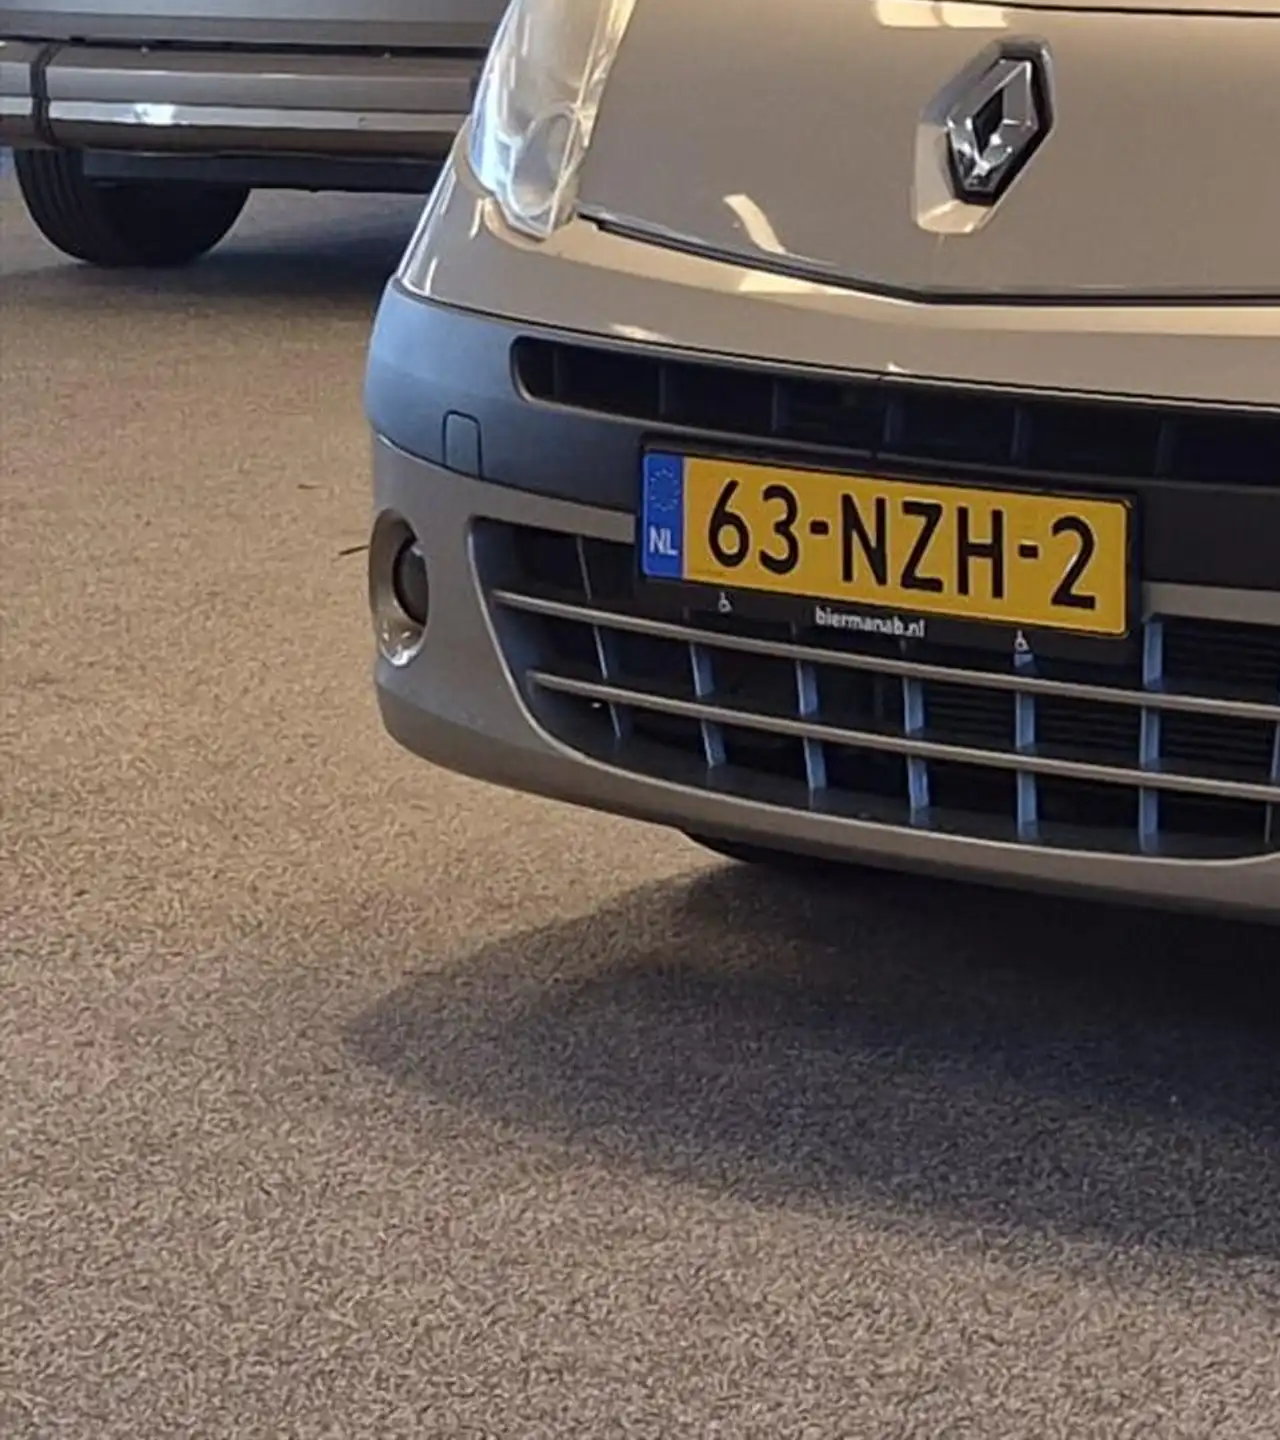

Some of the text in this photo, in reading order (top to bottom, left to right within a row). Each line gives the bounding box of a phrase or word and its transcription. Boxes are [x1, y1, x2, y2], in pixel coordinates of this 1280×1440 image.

[648, 479, 1097, 610] NL 63-NZH-2
[815, 605, 925, 639] biermanab.nl
